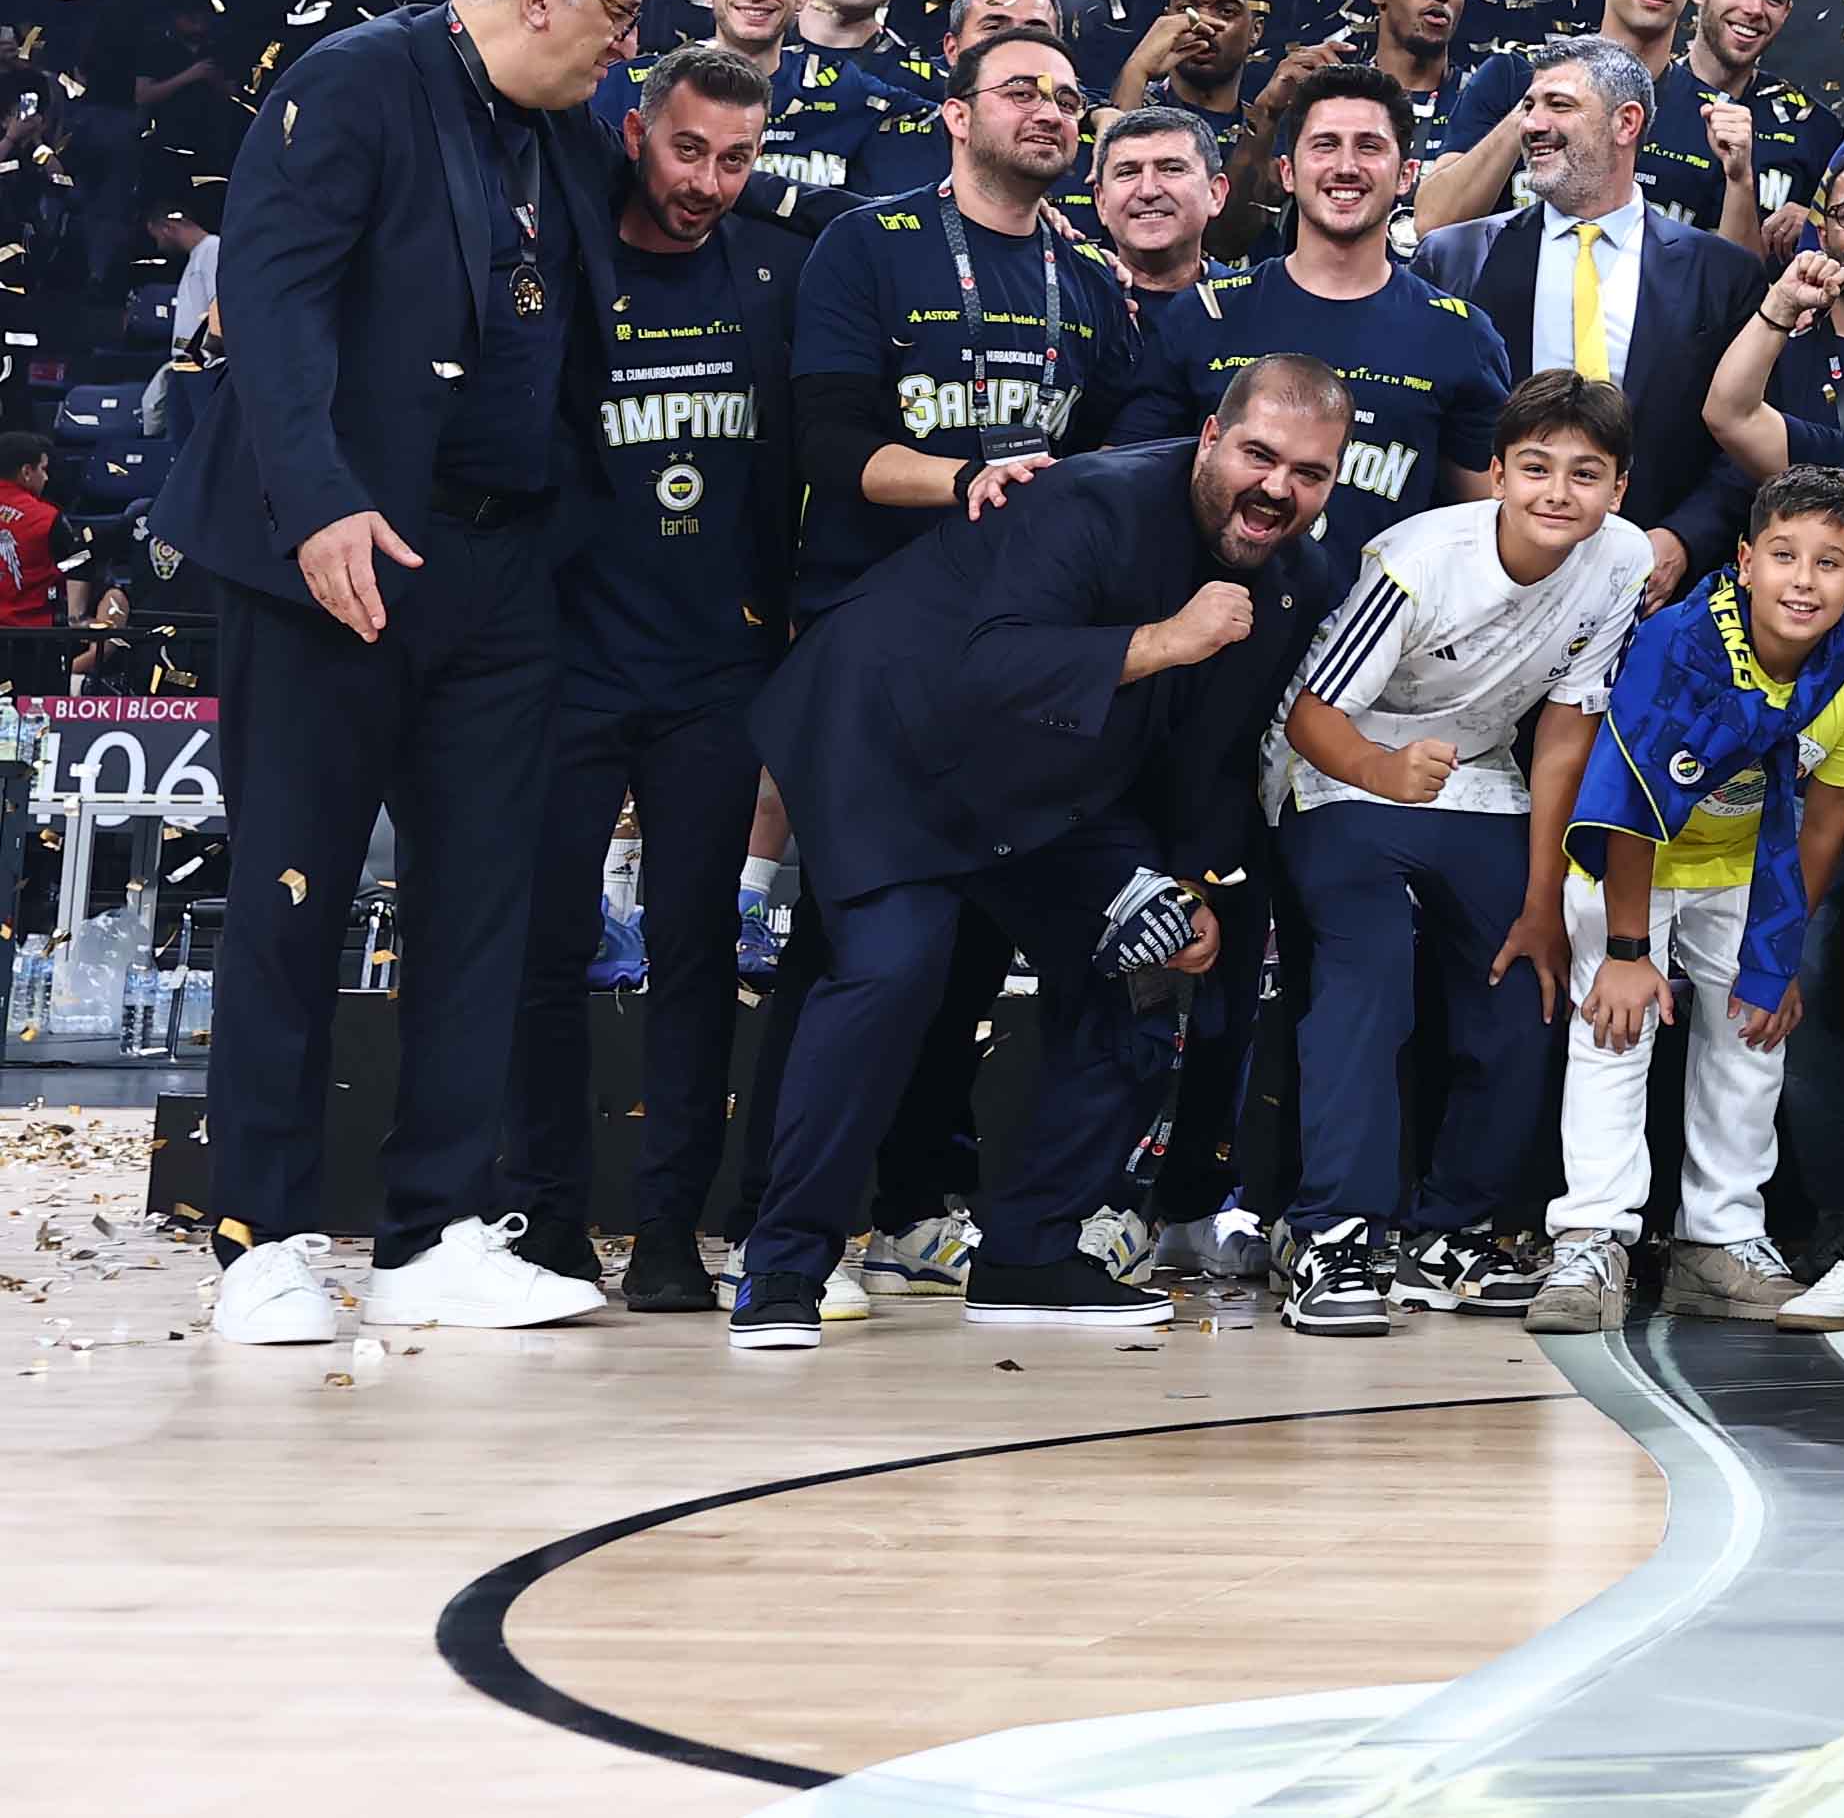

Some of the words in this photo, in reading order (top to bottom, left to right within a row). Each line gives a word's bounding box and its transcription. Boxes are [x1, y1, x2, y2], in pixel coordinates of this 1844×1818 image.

[1642, 142, 1684, 161] BİLFEN
[879, 213, 921, 231] tarfin
[1208, 276, 1252, 291] tarfin
[924, 311, 959, 321] ASTOR
[638, 327, 668, 339] Limak
[670, 325, 703, 338] Hotels
[611, 369, 624, 382] 39.
[706, 362, 733, 375] KUPASI
[1350, 367, 1400, 385] BİLFEN
[600, 388, 757, 446] AMPİYO
[660, 514, 699, 538] tarfin
[55, 700, 110, 719] BLOK
[127, 700, 199, 719] BLOCK
[36, 729, 219, 827] 106
